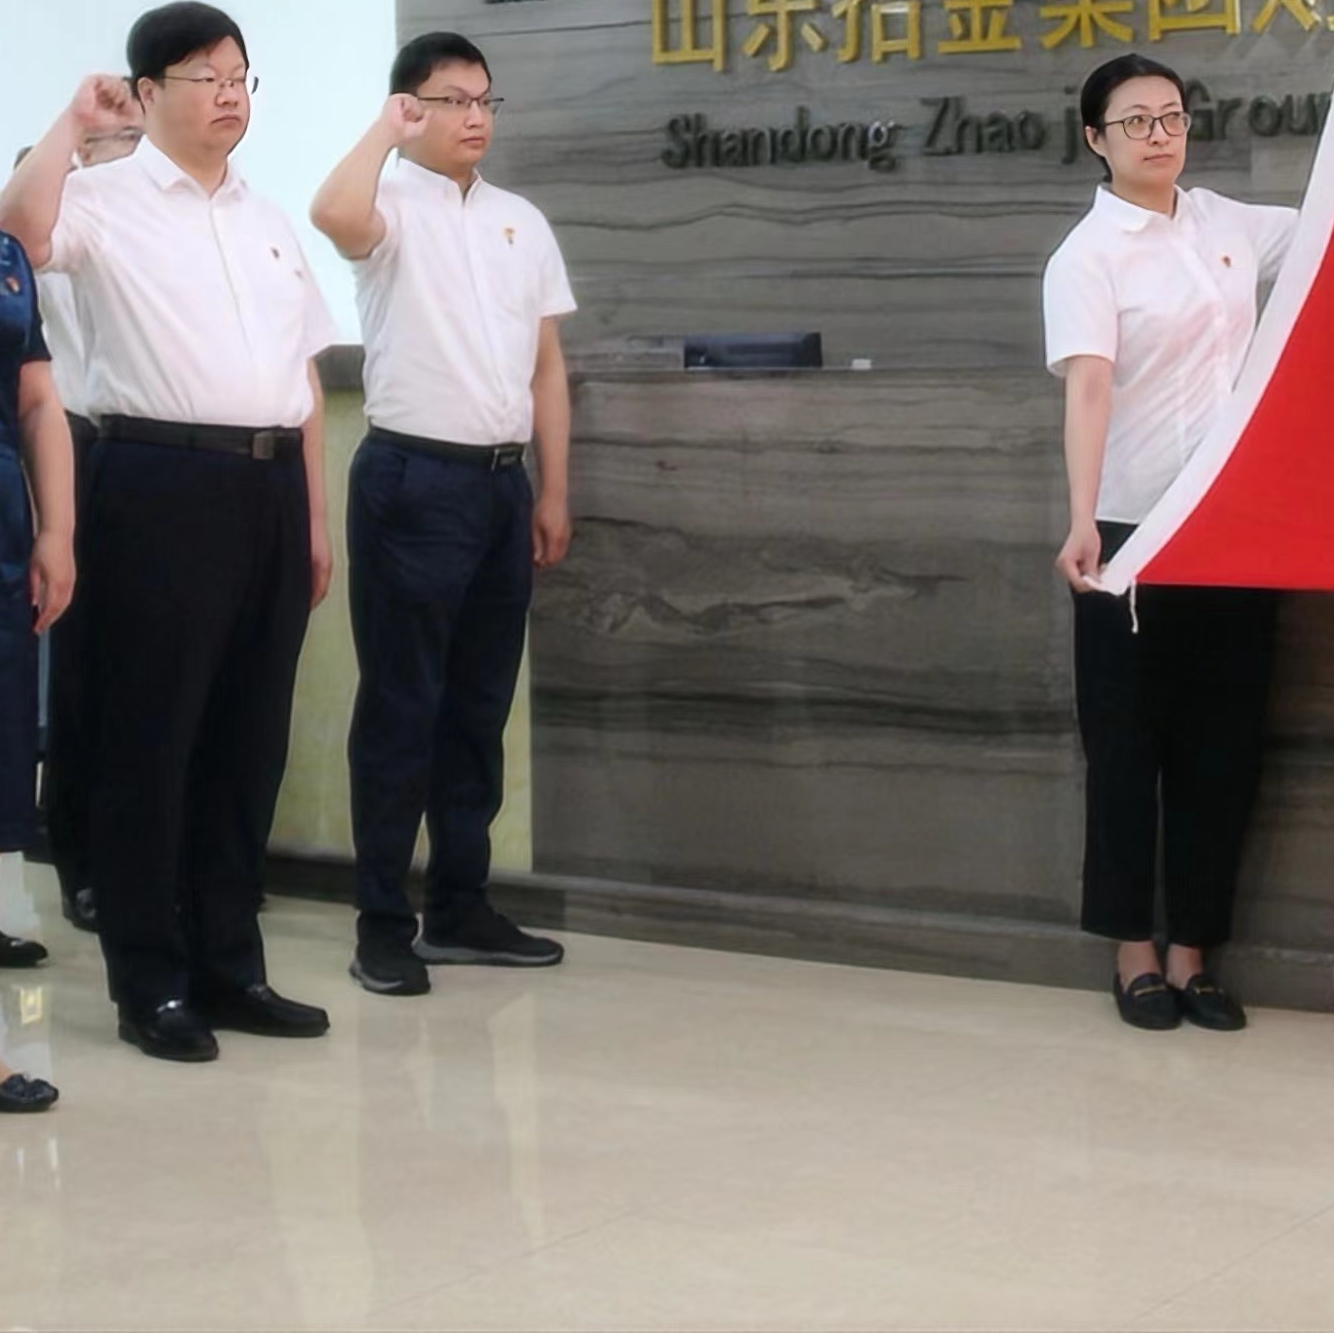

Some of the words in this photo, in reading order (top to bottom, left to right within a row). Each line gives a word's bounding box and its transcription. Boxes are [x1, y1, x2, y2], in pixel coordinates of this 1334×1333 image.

[661, 105, 902, 172] Shandong
[919, 96, 1046, 157] Zhao
[1183, 78, 1331, 140] Grou
